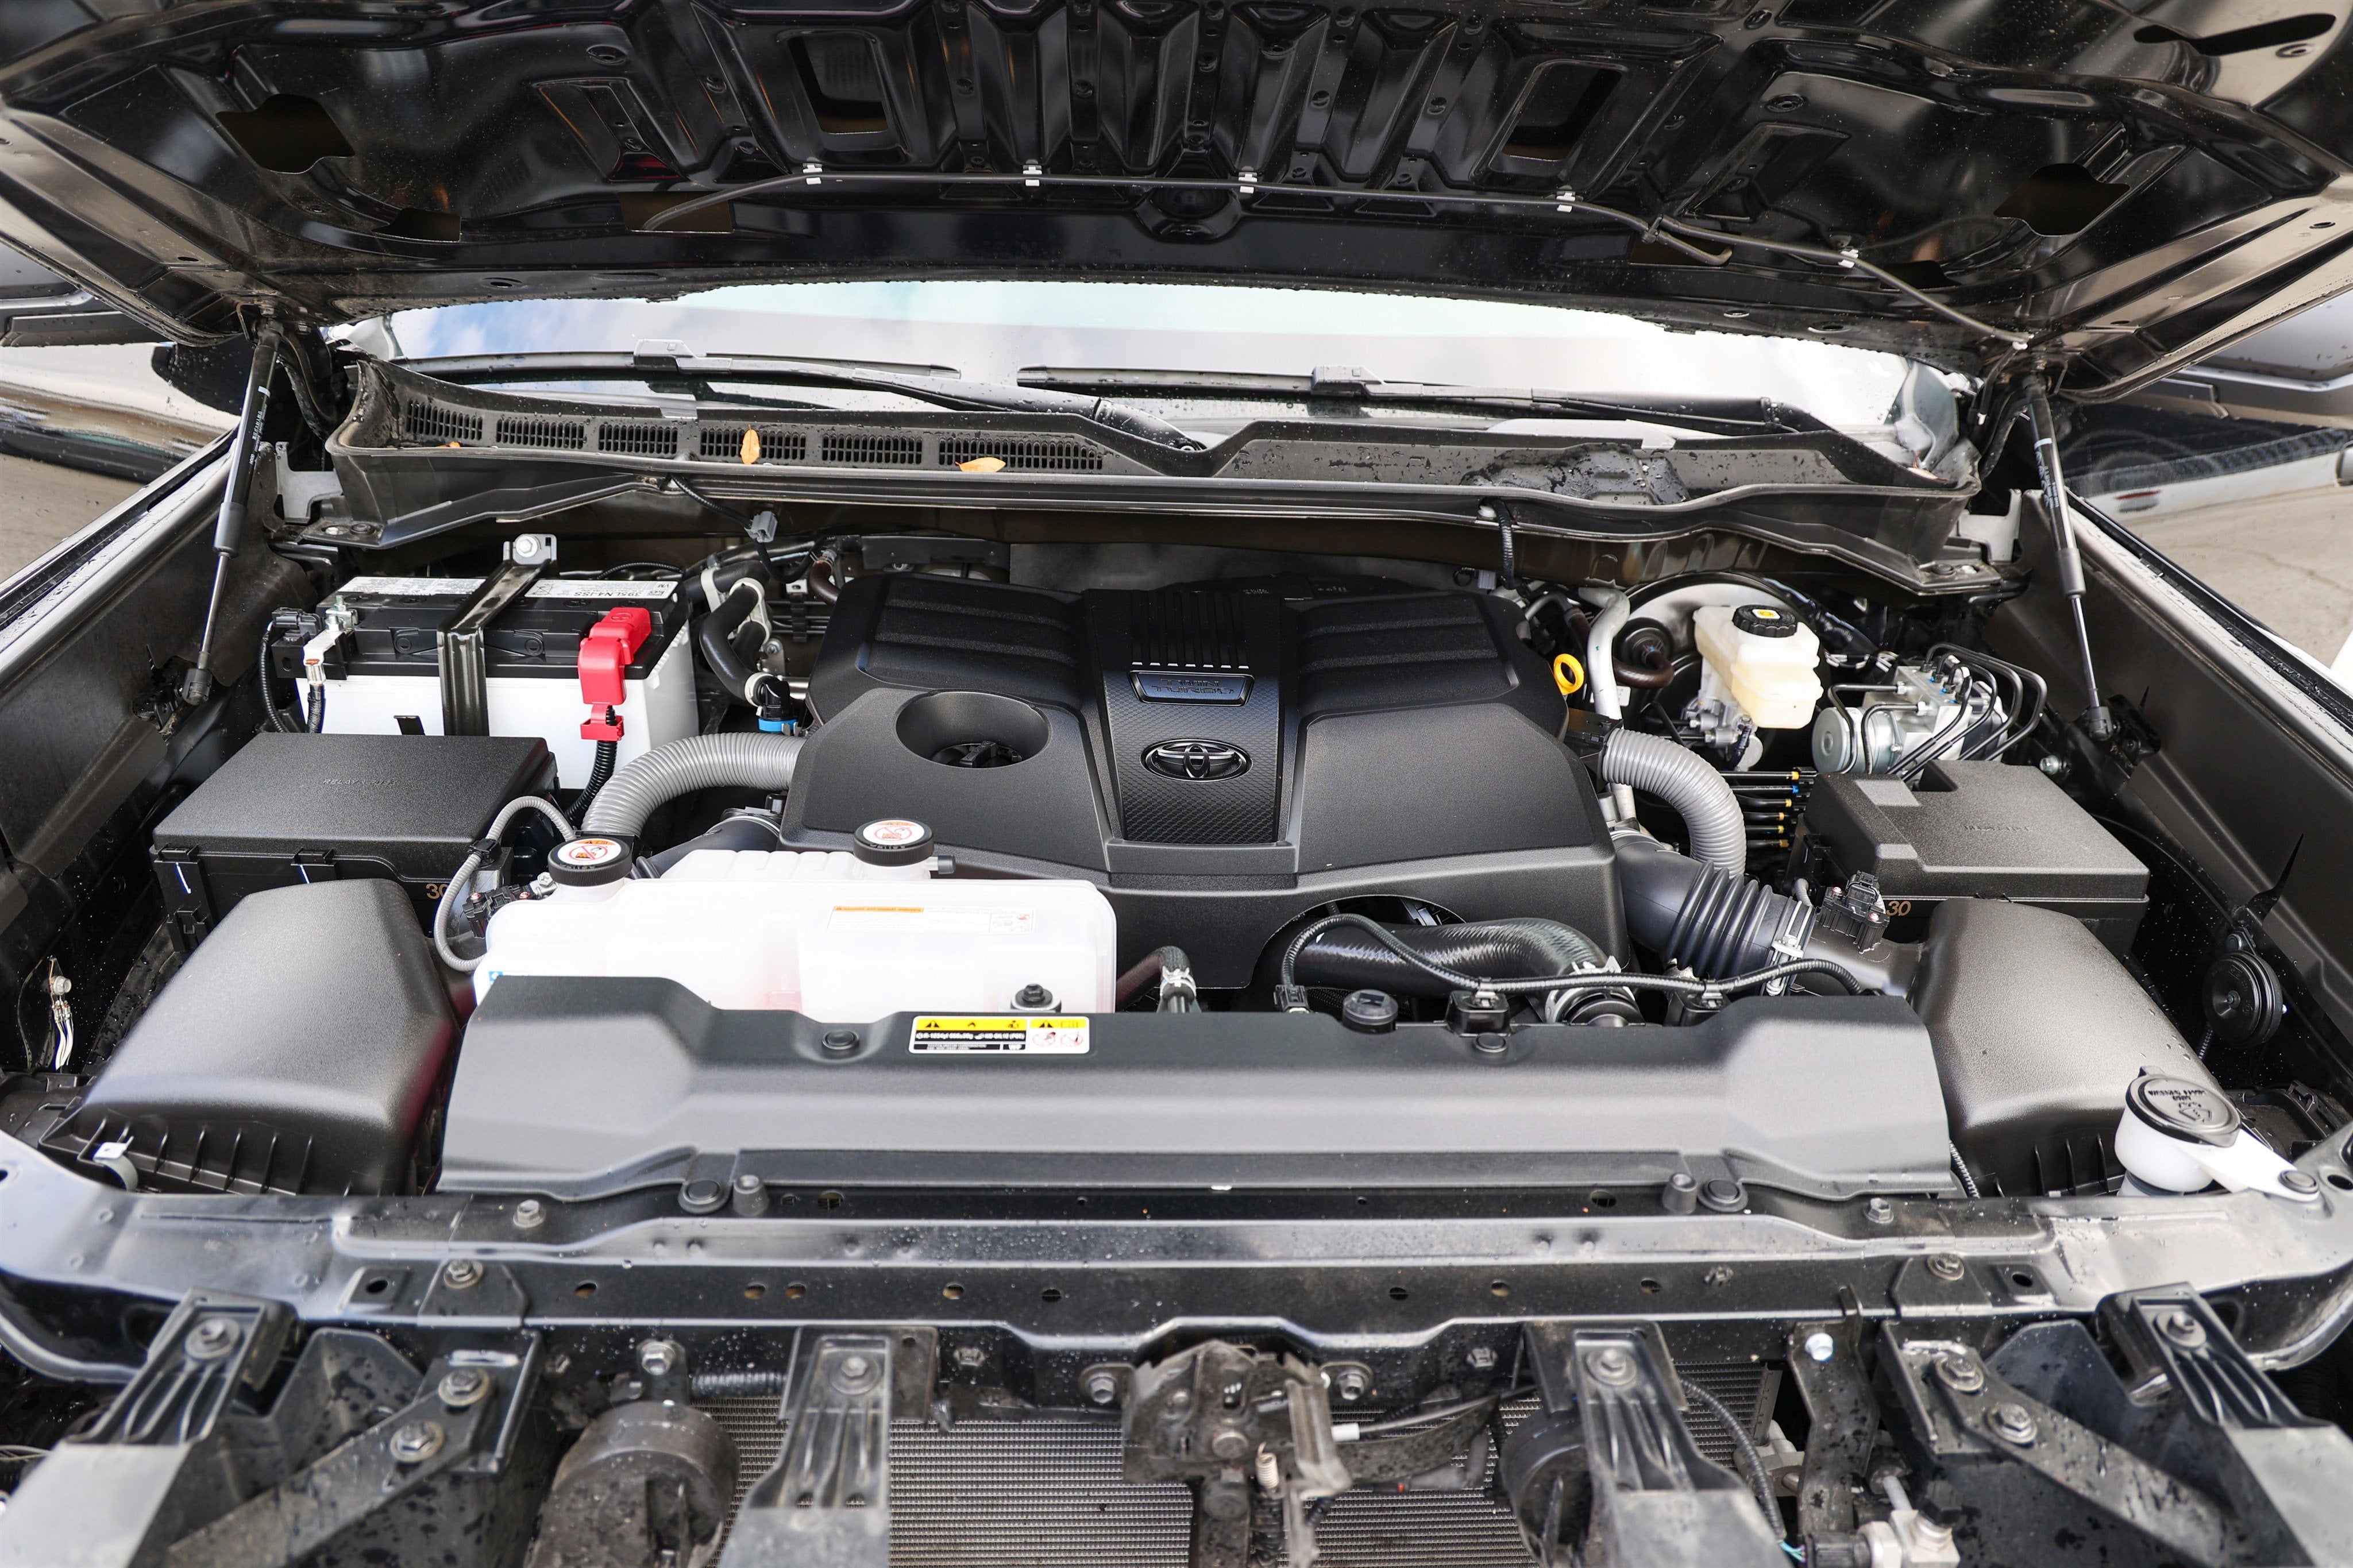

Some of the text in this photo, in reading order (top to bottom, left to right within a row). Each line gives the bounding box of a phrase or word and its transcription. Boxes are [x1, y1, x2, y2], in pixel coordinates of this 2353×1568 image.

[1160, 678, 1220, 687] TWIN
[1151, 686, 1235, 694] TURBO
[1886, 901, 1911, 916] 30
